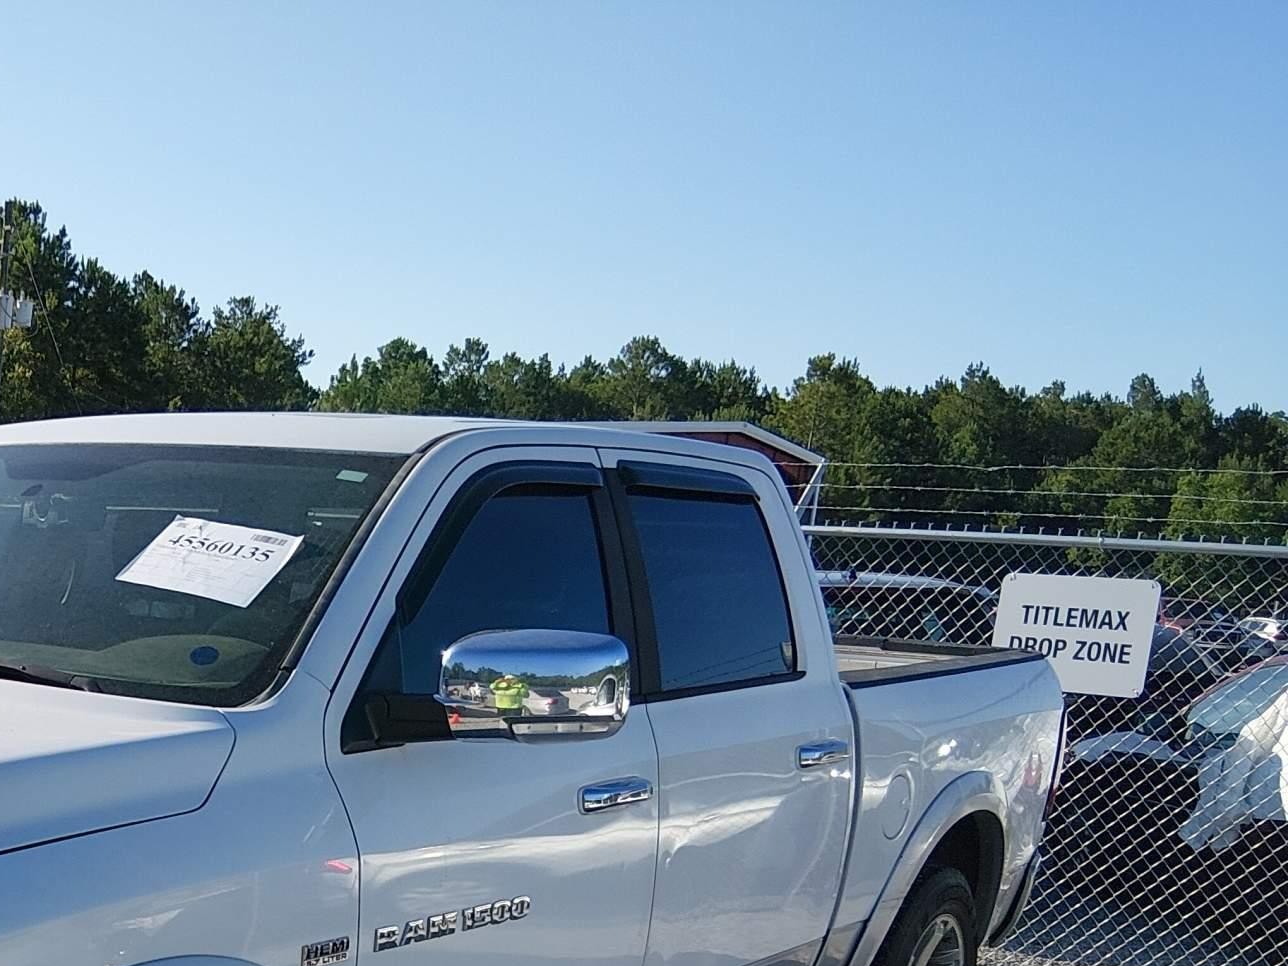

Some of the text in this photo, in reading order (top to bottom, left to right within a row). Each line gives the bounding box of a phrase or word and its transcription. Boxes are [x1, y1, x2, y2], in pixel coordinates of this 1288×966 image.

[168, 534, 275, 562] 45560135
[1021, 604, 1131, 632] TITLEMAX
[1072, 640, 1132, 664] ZONE
[373, 895, 531, 952] RAM 1500
[302, 936, 350, 960] HEMI
[322, 952, 348, 963] LITER
